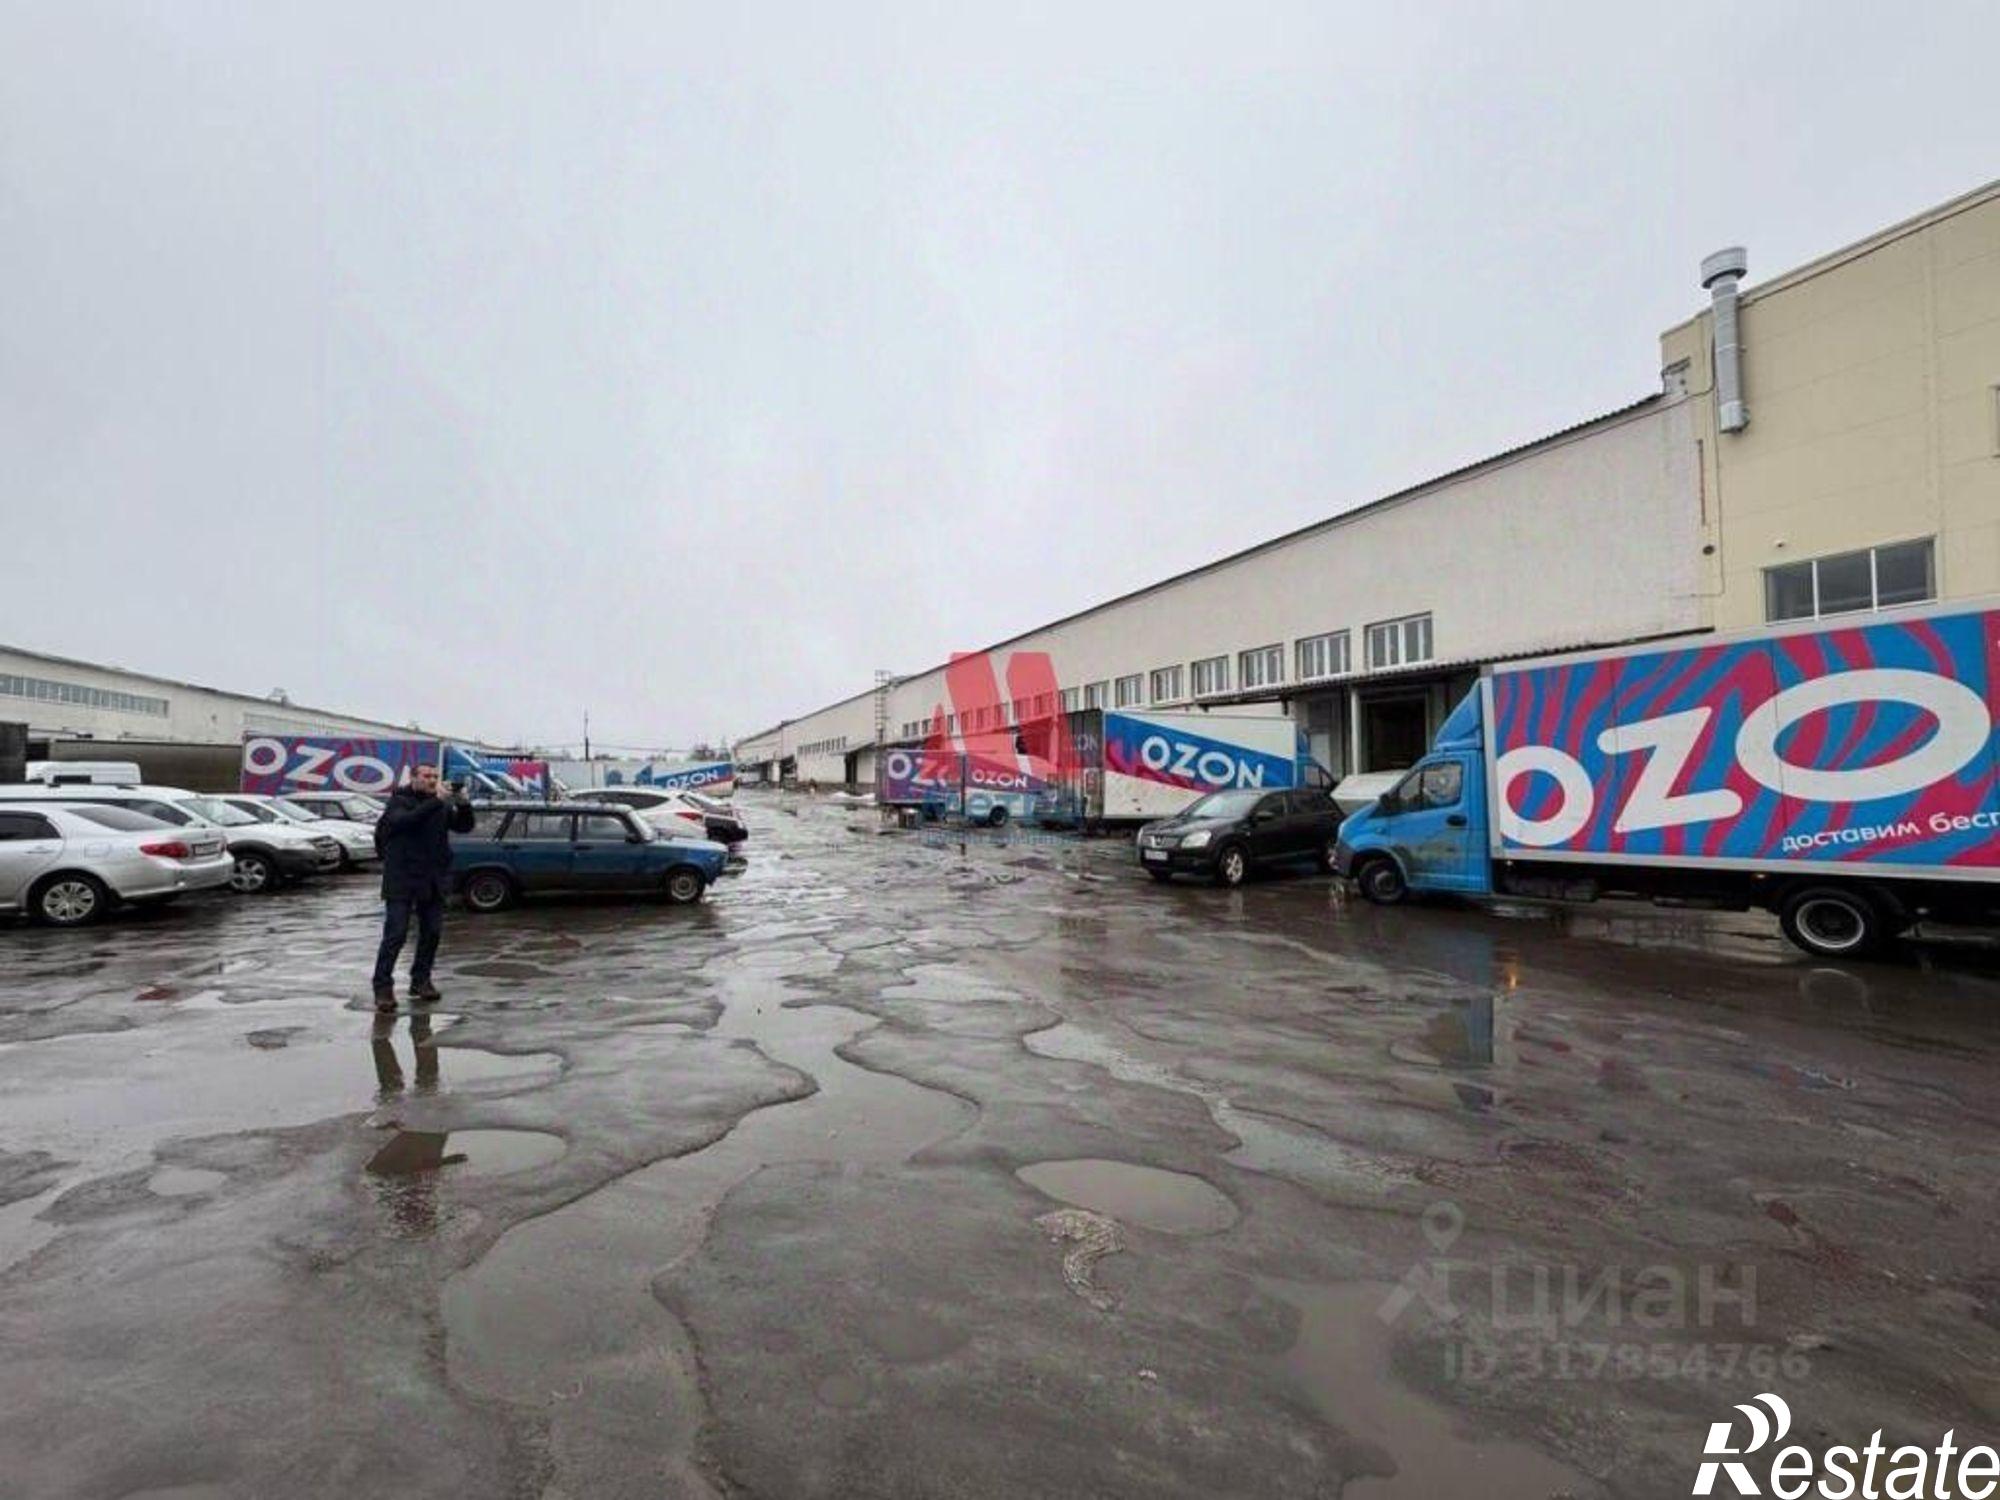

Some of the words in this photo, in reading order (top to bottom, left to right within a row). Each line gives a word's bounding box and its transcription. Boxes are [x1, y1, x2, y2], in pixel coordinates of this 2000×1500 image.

[1141, 735, 1264, 788] OZON
[666, 769, 719, 789] OZON
[971, 768, 1028, 788] OZON
[1781, 821, 1921, 852] доставим
